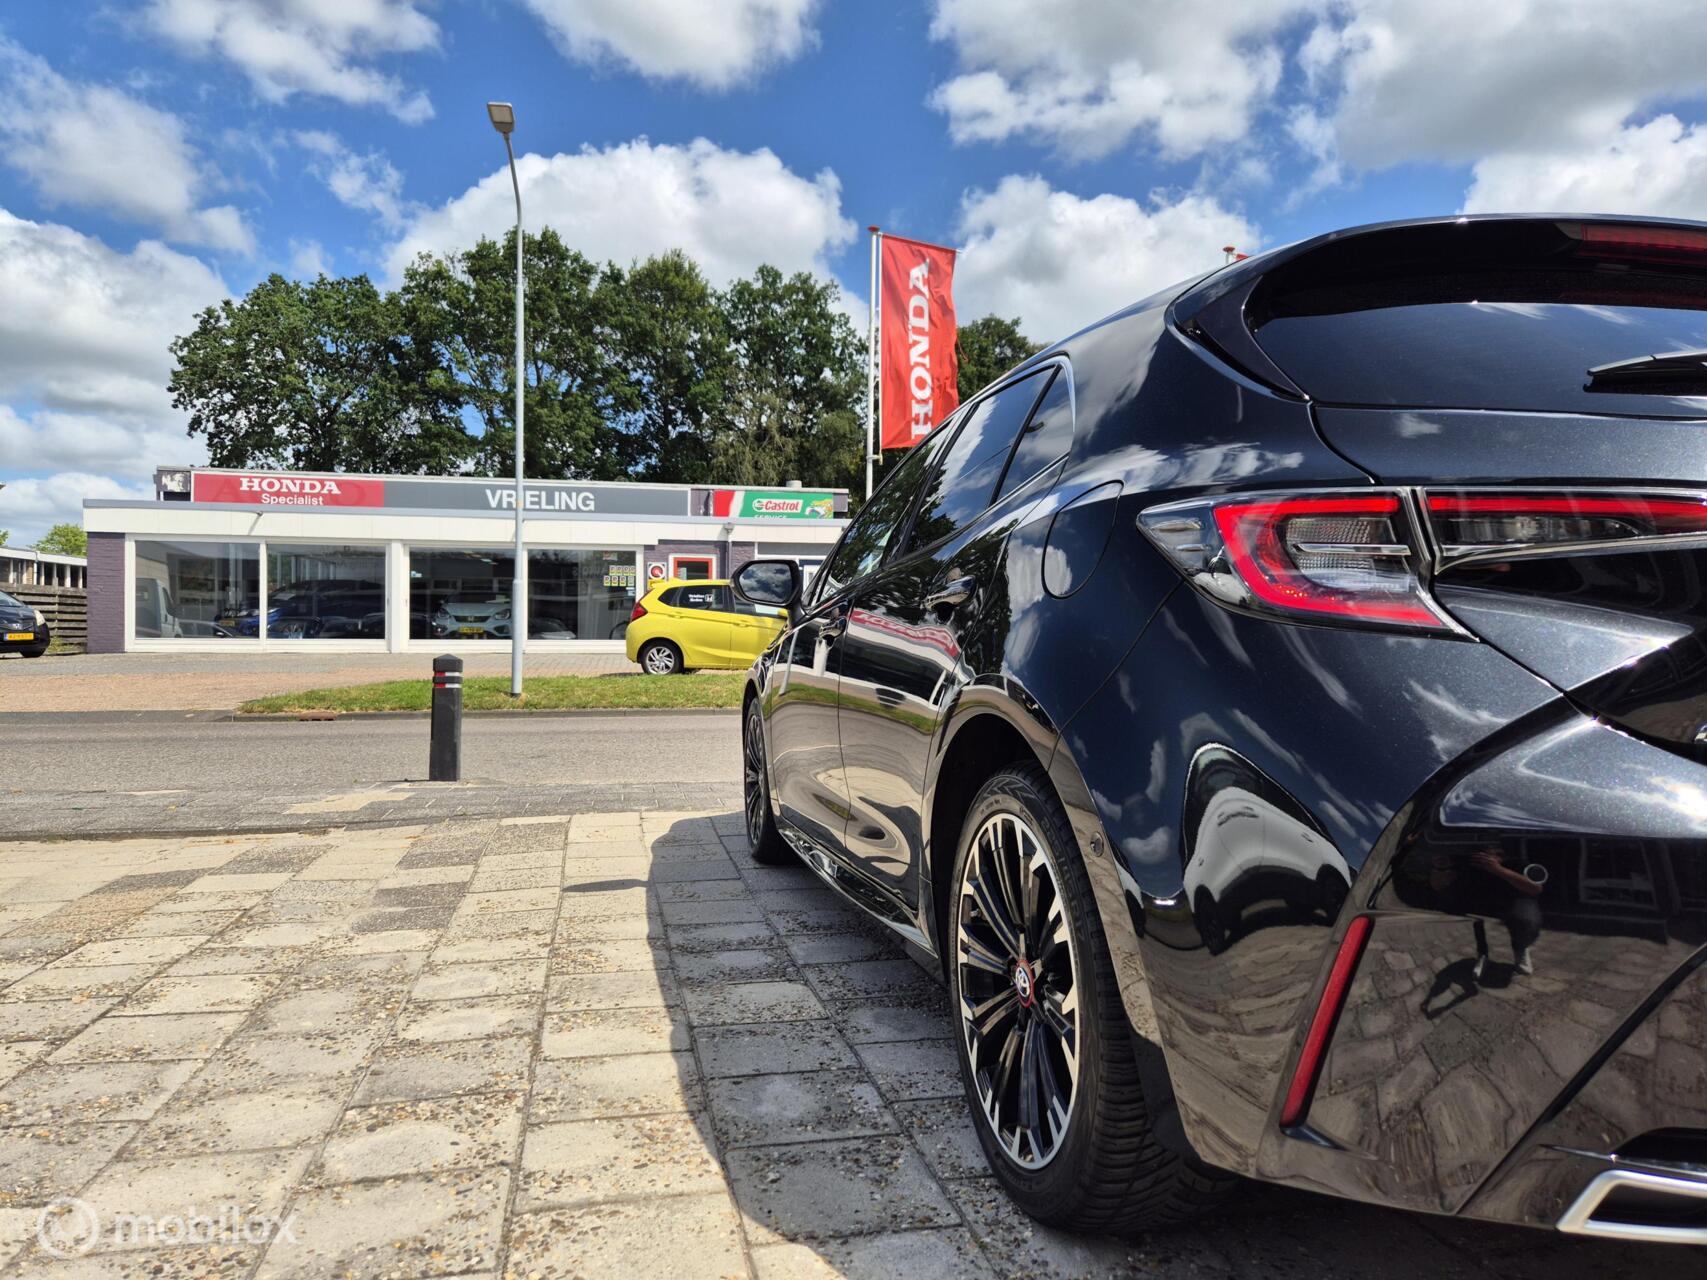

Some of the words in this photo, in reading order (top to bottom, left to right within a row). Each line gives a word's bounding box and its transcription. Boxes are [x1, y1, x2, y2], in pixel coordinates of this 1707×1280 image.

[909, 258, 932, 439] HONDA
[240, 478, 341, 494] HONDA
[262, 494, 323, 505] Specialist
[485, 489, 595, 511] VRELING
[765, 501, 799, 511] Castrol
